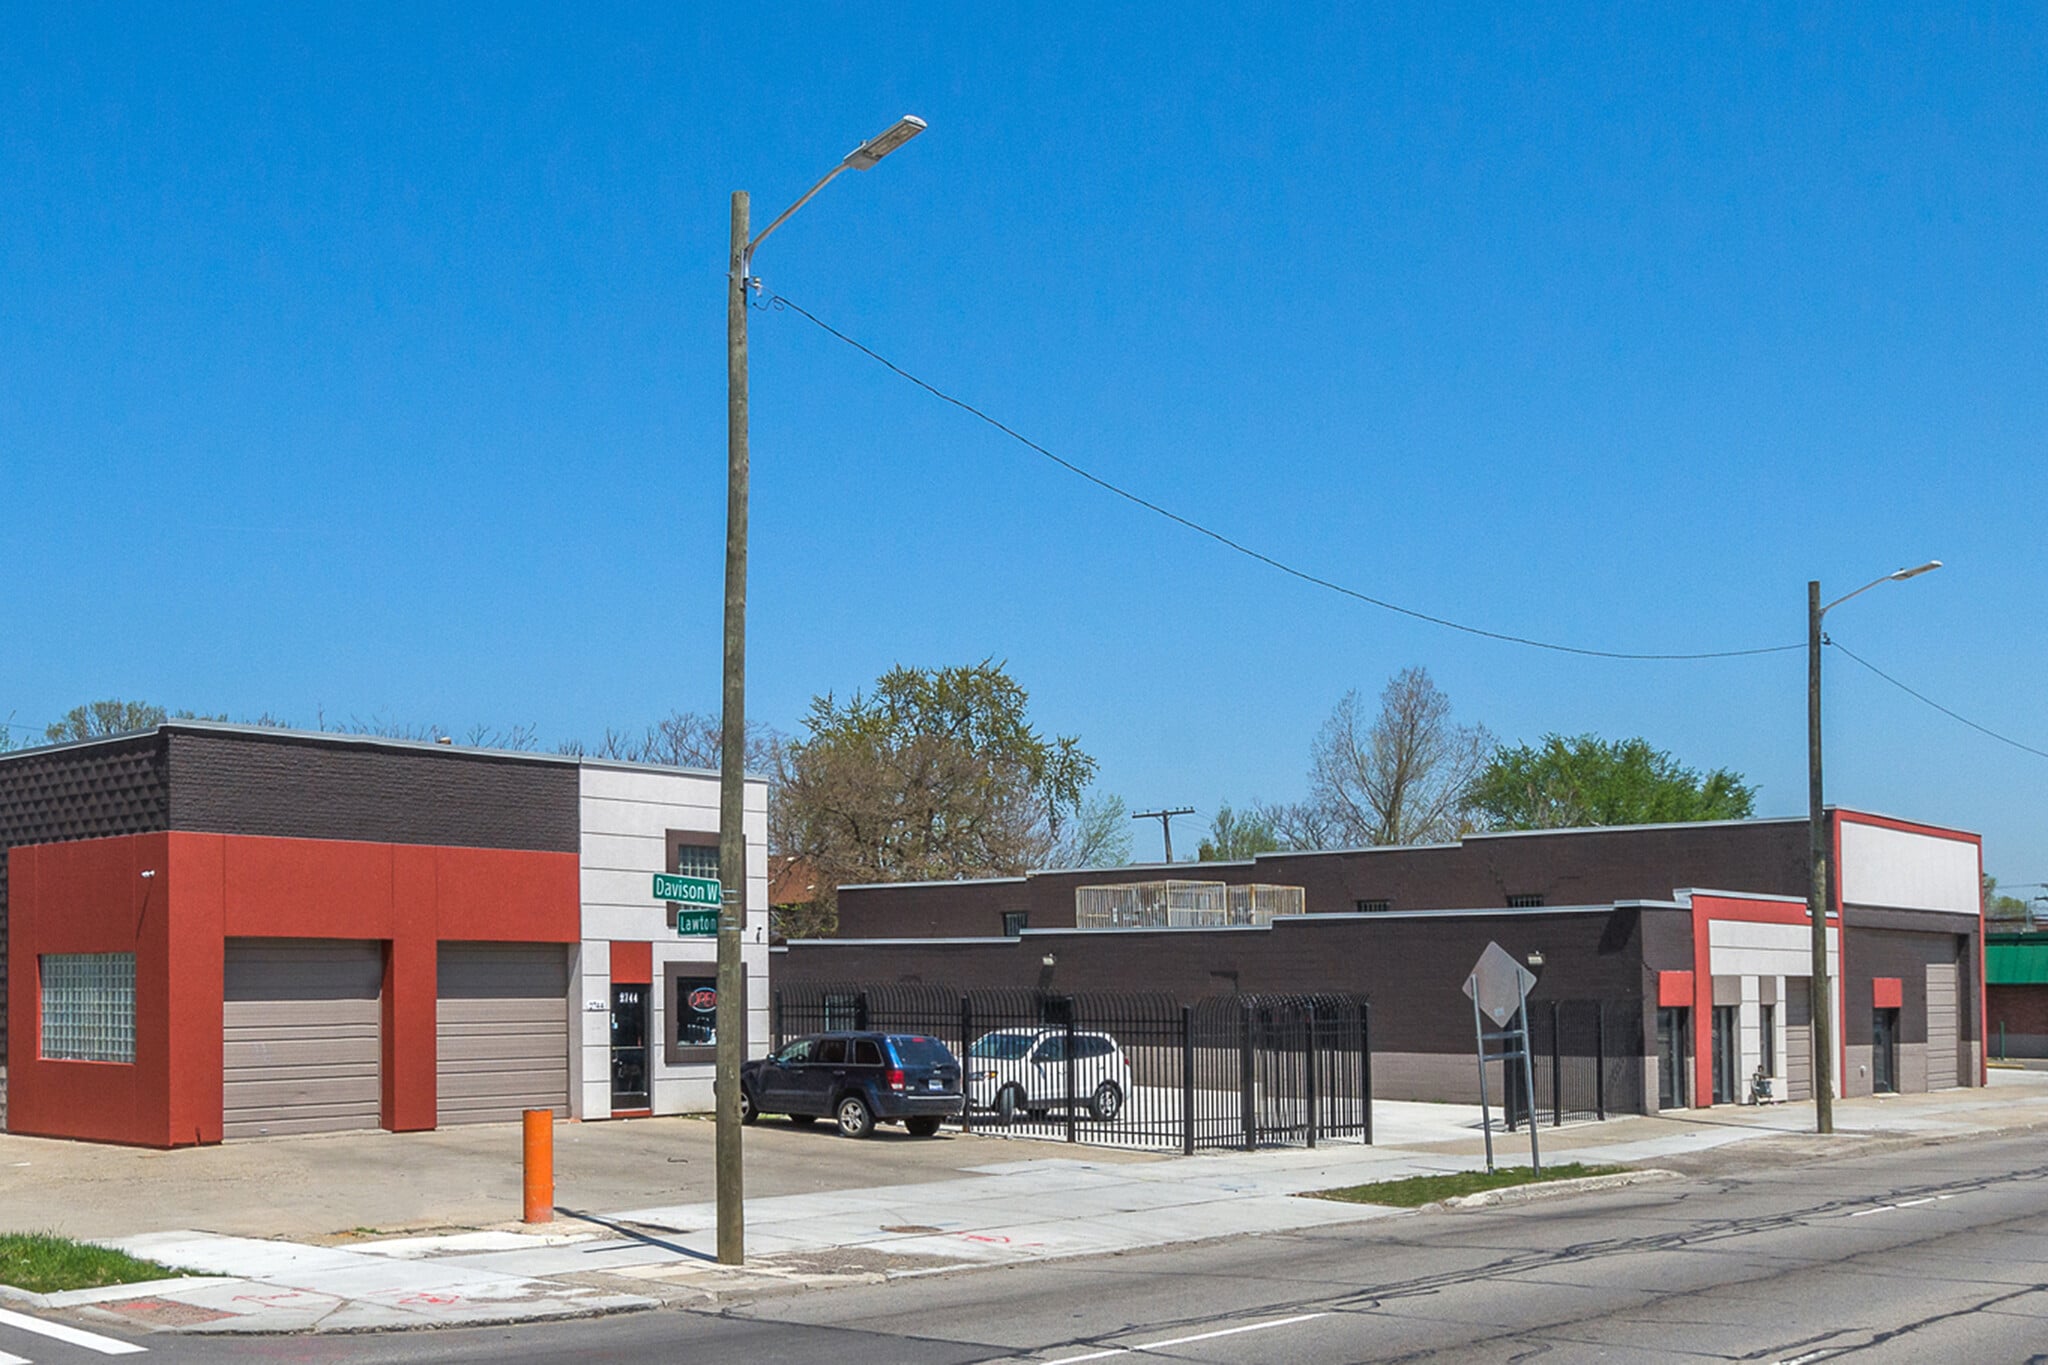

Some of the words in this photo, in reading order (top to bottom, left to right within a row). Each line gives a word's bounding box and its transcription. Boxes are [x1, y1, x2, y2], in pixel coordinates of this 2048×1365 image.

[656, 877, 705, 900] Davison
[707, 883, 718, 901] W
[680, 915, 717, 932] Lawton
